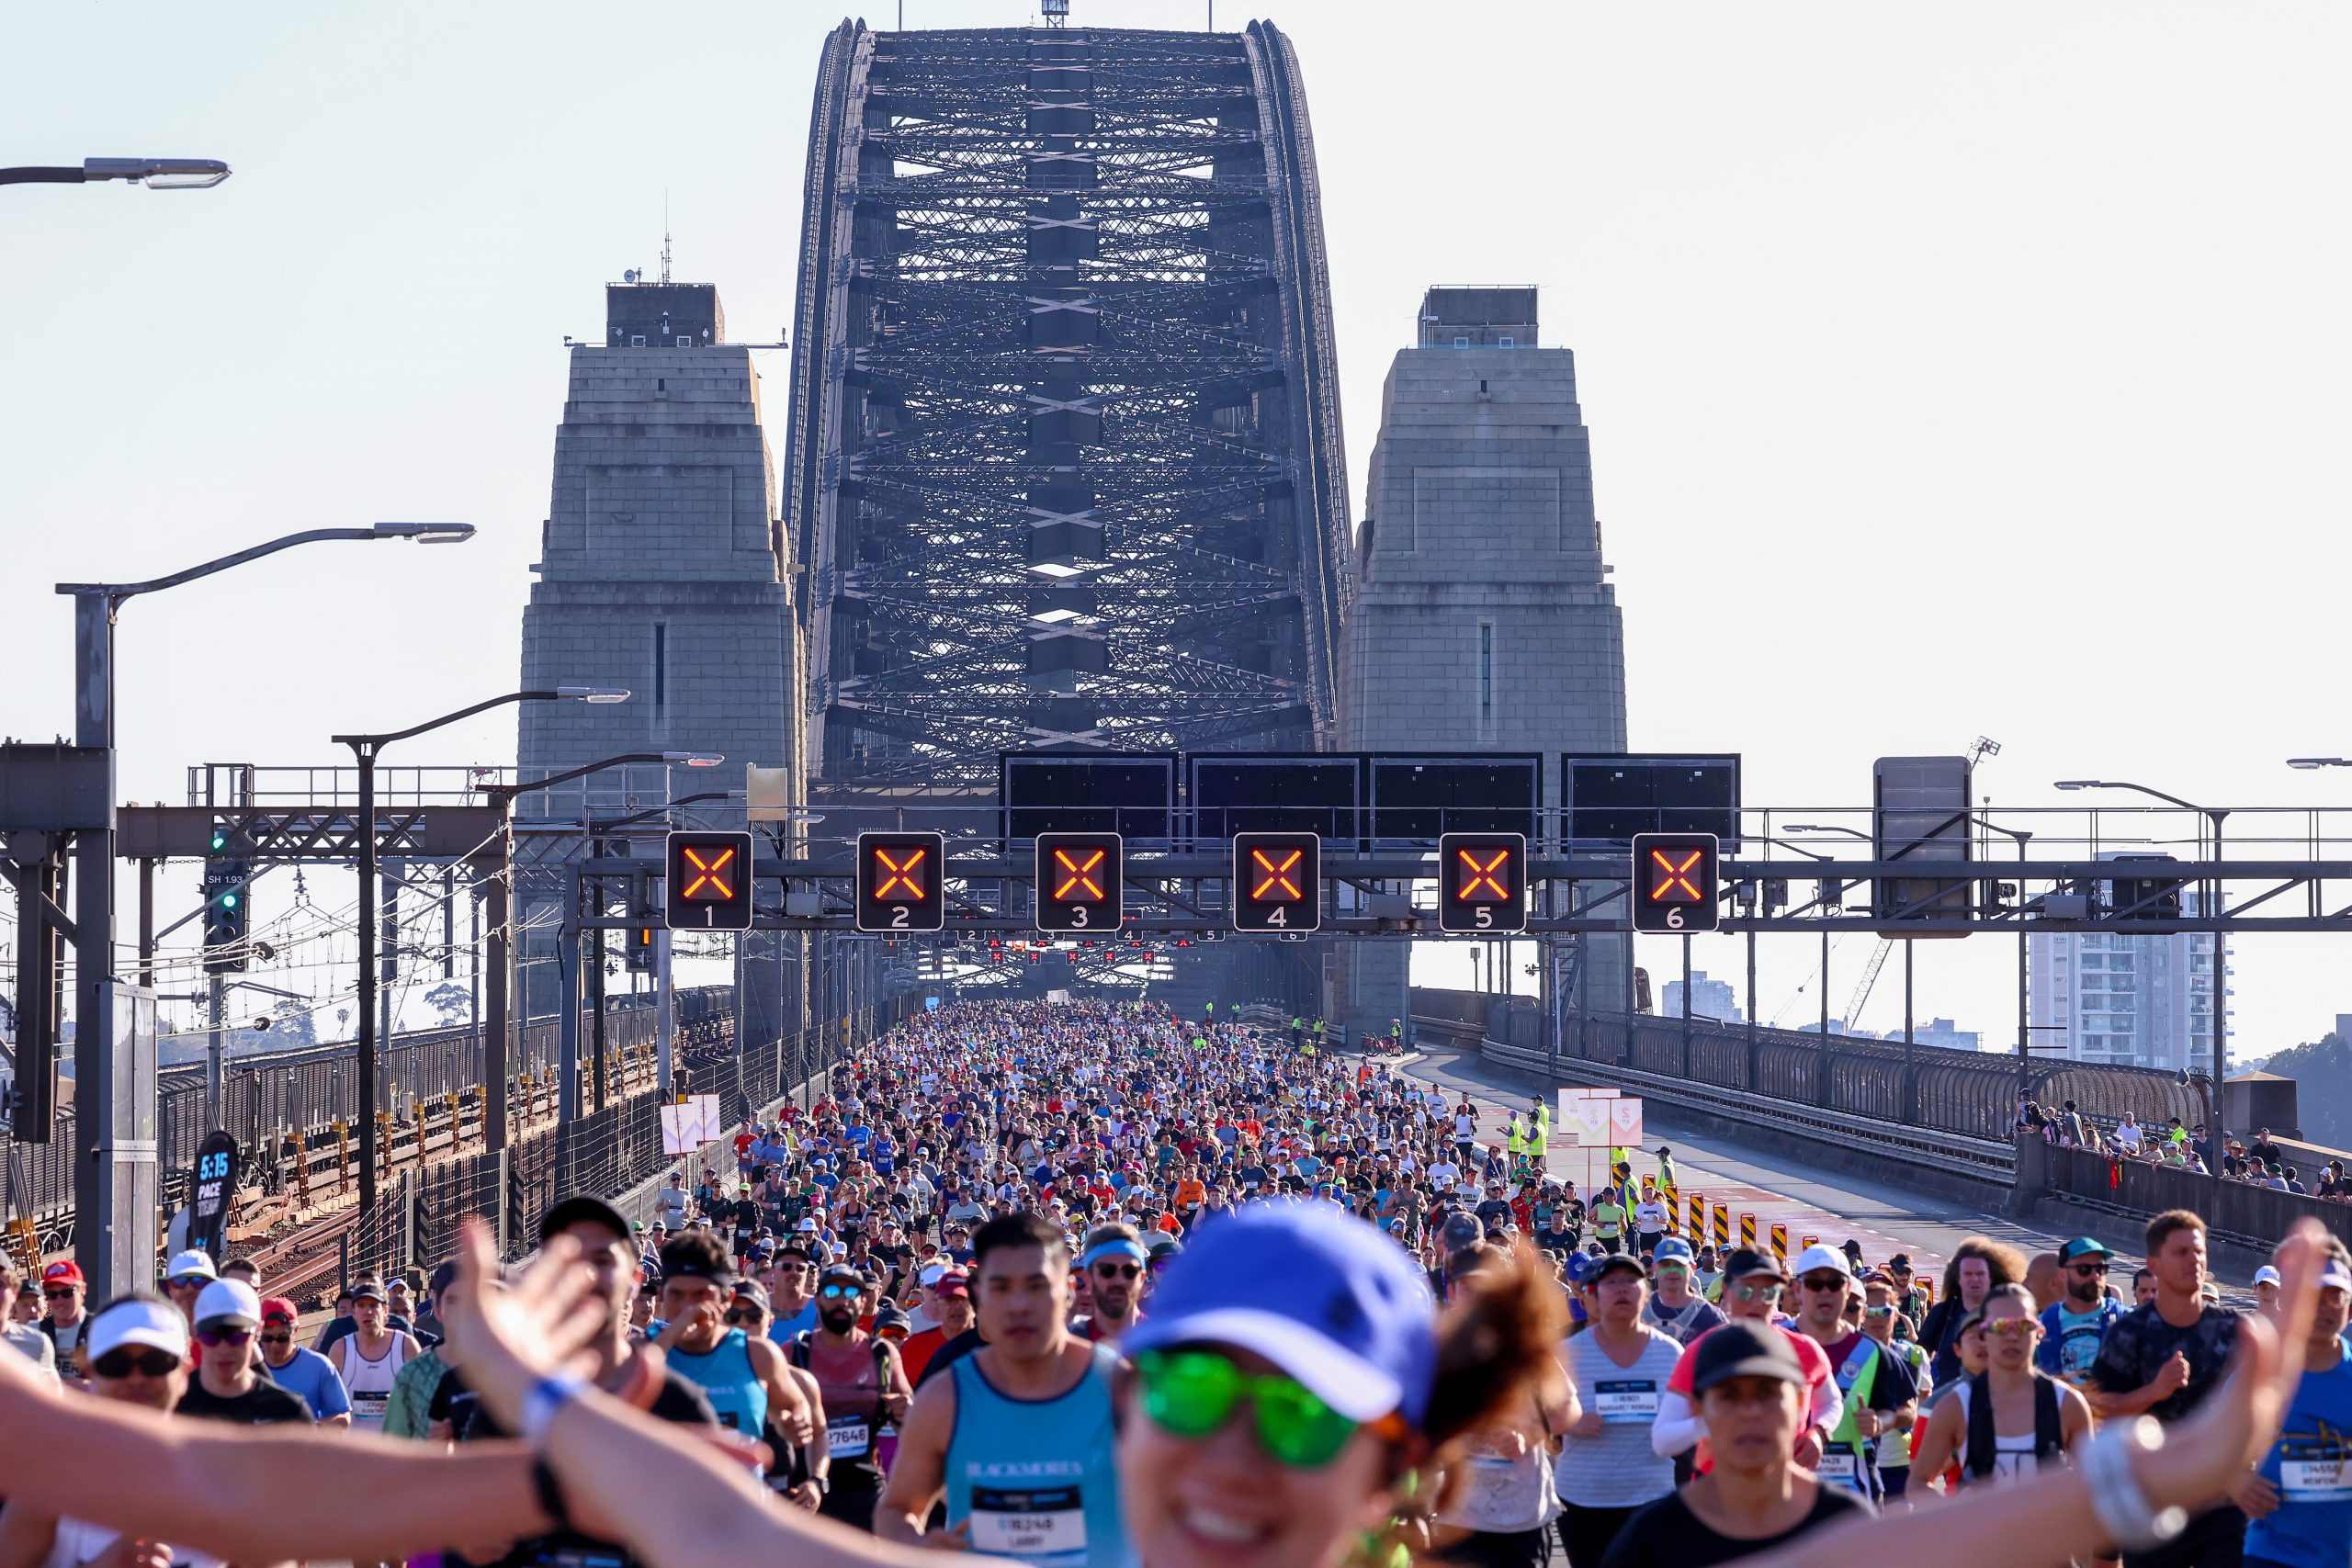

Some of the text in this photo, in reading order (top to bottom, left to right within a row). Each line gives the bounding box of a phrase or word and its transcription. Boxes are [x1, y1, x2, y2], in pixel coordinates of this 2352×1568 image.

[208, 875, 243, 884] SH 1.93
[705, 906, 713, 927] 1
[891, 906, 910, 927] 2
[1071, 906, 1088, 927] 3
[1267, 906, 1287, 927] 4
[1475, 907, 1493, 928] 5
[1667, 907, 1684, 928] 6
[967, 931, 976, 940] 2
[1124, 931, 1134, 940] 4
[1206, 931, 1216, 941] 5
[199, 1152, 228, 1180] 5:15
[198, 1181, 222, 1201] PACE
